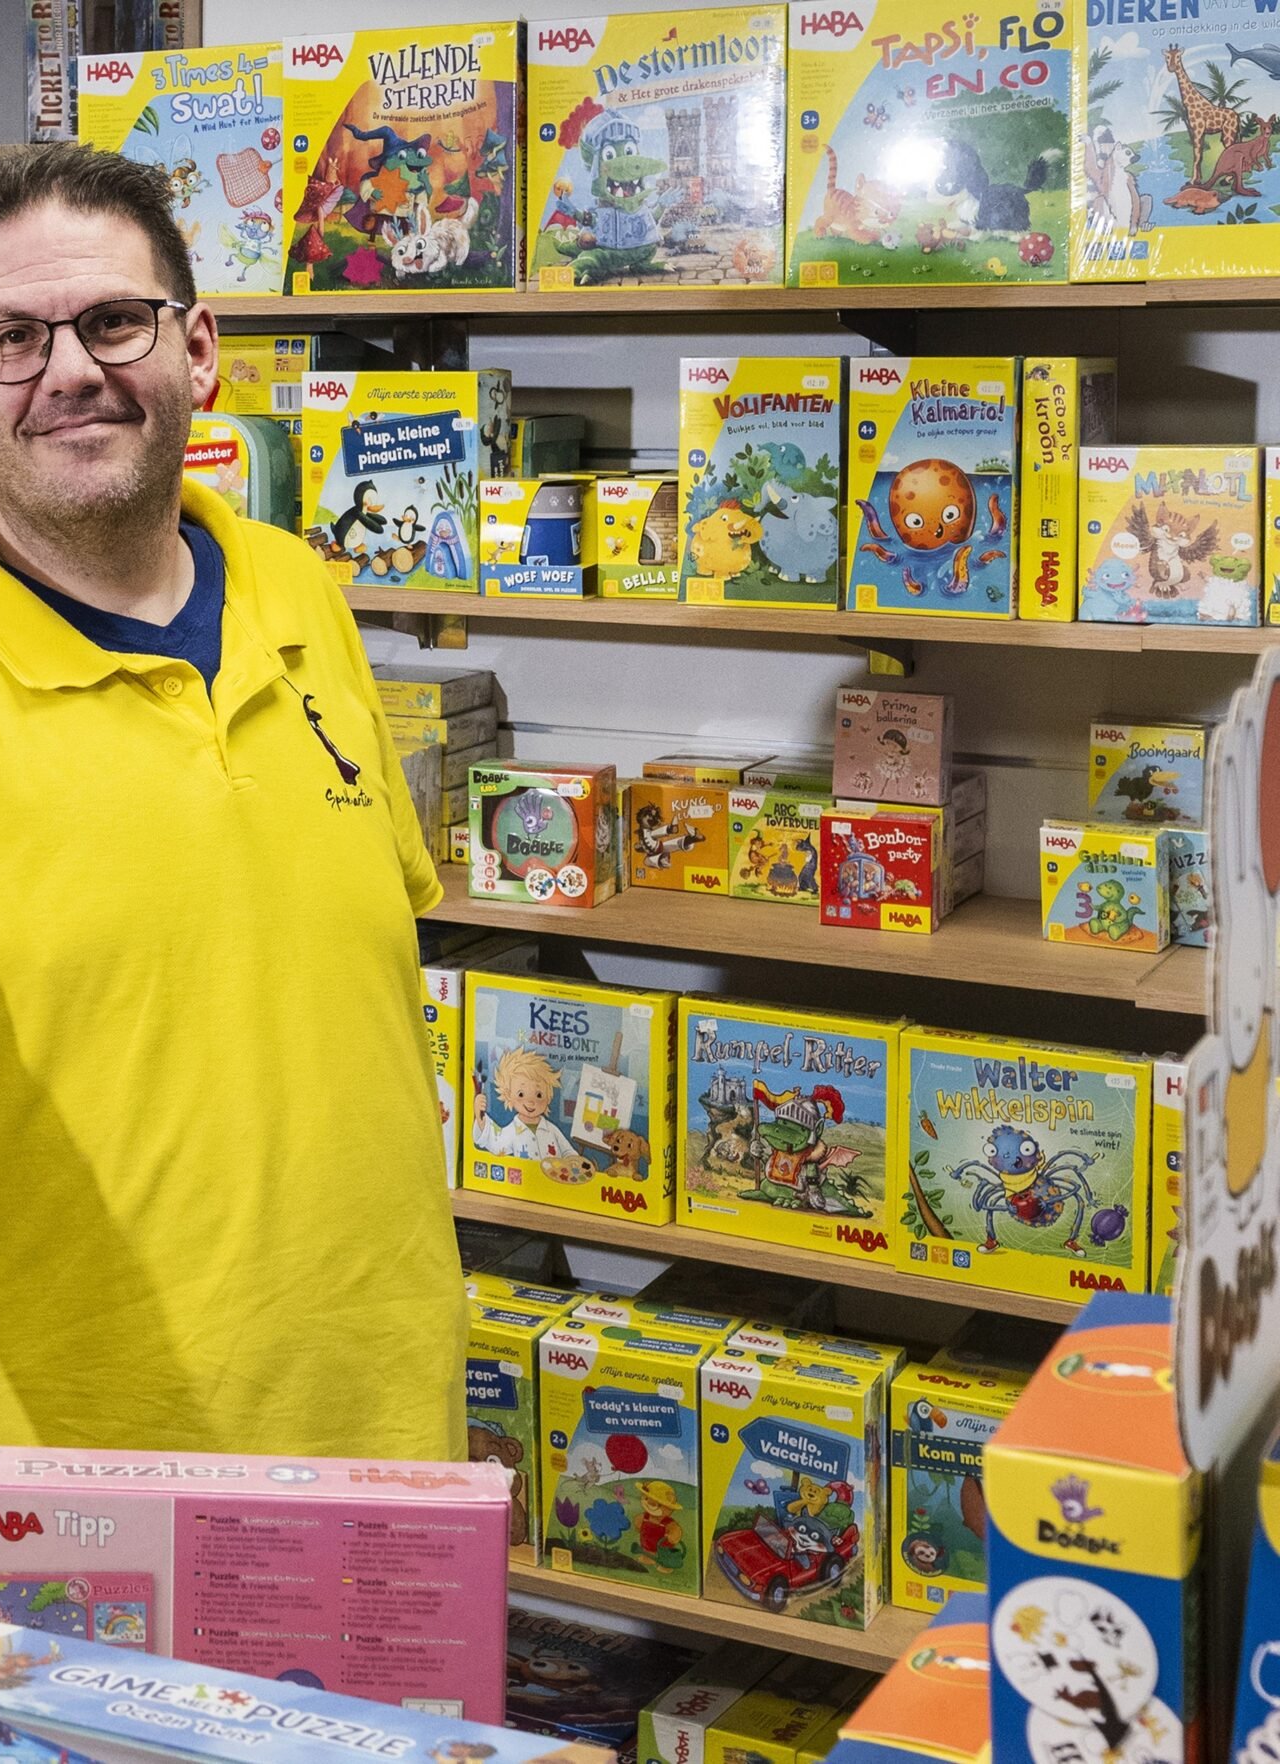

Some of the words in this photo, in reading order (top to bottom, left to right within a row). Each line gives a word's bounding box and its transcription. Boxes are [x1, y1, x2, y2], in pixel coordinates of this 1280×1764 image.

[801, 10, 864, 37] HABA
[1086, 0, 1200, 27] DIEREN
[40, 24, 53, 46] TO
[999, 10, 1065, 54] FLO
[1169, 22, 1228, 36] ontdekking
[538, 28, 596, 52] HABA
[292, 44, 344, 68] HABA
[368, 43, 481, 86] VALLENDE
[87, 60, 134, 84] HABA
[152, 69, 166, 89] 3
[165, 54, 233, 88] Times
[592, 62, 633, 97] De
[925, 68, 985, 99] EN
[999, 59, 1049, 89] CO
[36, 49, 63, 132] TICKET
[382, 78, 477, 110] STERREN
[630, 86, 651, 101] Het
[654, 83, 680, 99] grote
[1000, 97, 1053, 113] speelgoed!
[201, 121, 217, 132] Wild
[219, 120, 237, 130] Hunt
[688, 367, 730, 385] HABA
[859, 367, 902, 386] HABA
[309, 381, 348, 401] HABA
[367, 388, 392, 401] Mijn
[393, 388, 420, 400] eerste
[421, 388, 457, 402] spellen
[909, 378, 971, 402] Kleine
[712, 391, 835, 421] VOLIFANTEN
[910, 394, 1006, 426] Kalmario!
[363, 431, 395, 448] Hup,
[397, 424, 441, 441] kleine
[946, 428, 974, 437] octopus
[357, 443, 417, 471] pinguïn,
[419, 437, 452, 462] hup!
[1088, 456, 1130, 473] HABA
[503, 570, 538, 589] WOEF
[541, 569, 576, 584] WOEF
[622, 570, 666, 590] BELLA
[1034, 551, 1060, 607] HABA
[842, 693, 872, 707] HABA
[881, 698, 918, 715] Prima
[876, 711, 918, 726] ballerina
[1095, 728, 1127, 743] HABA
[1126, 741, 1201, 764] Boomgaard
[472, 770, 510, 785] DOBBLE
[671, 795, 707, 812] KUNG
[731, 797, 760, 811] HABA
[773, 802, 798, 818] ABC
[506, 833, 565, 857] DOBBLE
[863, 827, 929, 851] Bonbon-
[1045, 835, 1078, 850] HABA
[887, 846, 923, 865] party
[691, 873, 721, 889] HABA
[888, 911, 923, 928] HABA
[440, 977, 449, 1002] HABA
[529, 1002, 590, 1036] KEES
[973, 1057, 1079, 1093] Walter
[935, 1087, 1095, 1132] Wikkelspin
[1093, 1138, 1121, 1152] wint!
[601, 1186, 648, 1213] HABA
[836, 1224, 889, 1253] HABA
[548, 1350, 589, 1371] HABA
[600, 1365, 623, 1378] Mijn
[624, 1369, 650, 1382] eerste
[651, 1373, 684, 1388] spellen
[708, 1378, 752, 1401] HABA
[589, 1399, 630, 1414] Teddy's
[631, 1400, 675, 1415] kleuren
[760, 1393, 779, 1407] My
[779, 1395, 802, 1411] Very
[801, 1399, 826, 1413] First
[604, 1416, 620, 1426] en
[620, 1416, 663, 1428] vormen
[955, 1416, 988, 1434] Mijn
[776, 1429, 823, 1457] Hello,
[917, 1442, 956, 1462] Kom
[759, 1438, 839, 1475] Vacation!
[17, 1458, 248, 1481] Puzzles
[269, 1465, 317, 1481] 3+
[348, 1467, 472, 1490] HABA
[53, 1509, 117, 1548] Tipp
[209, 1515, 241, 1526] Puzzles
[1036, 1519, 1121, 1556] DOBBLE
[209, 1572, 240, 1582] Puzzles
[357, 1578, 388, 1588] Puzzles
[92, 1582, 151, 1598] Puzzles
[208, 1628, 240, 1639] Puzzles
[355, 1634, 384, 1645] Puzzle
[51, 1665, 181, 1703] GAME
[243, 1702, 413, 1760] PUZZLE
[107, 1701, 193, 1733] Ocean
[196, 1717, 271, 1748] Twist
